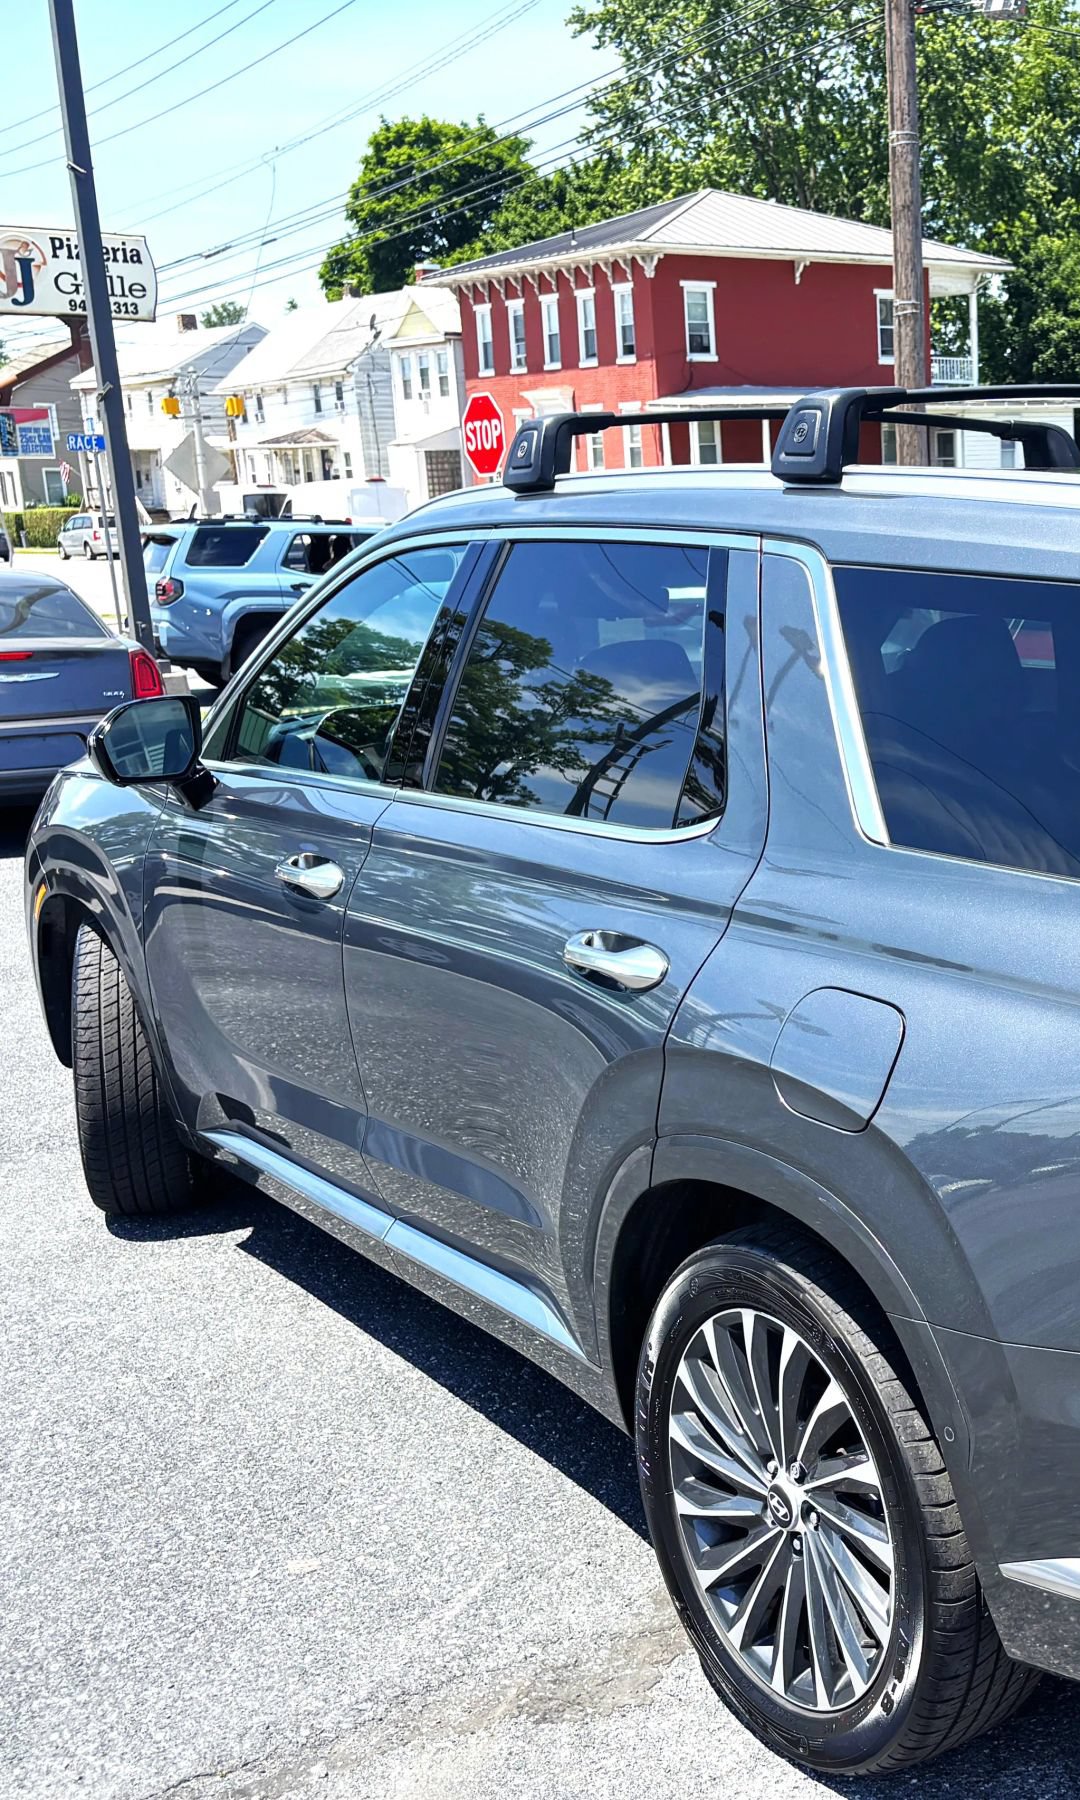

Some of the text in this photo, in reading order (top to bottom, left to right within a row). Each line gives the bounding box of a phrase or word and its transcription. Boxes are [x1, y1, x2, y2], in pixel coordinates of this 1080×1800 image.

[49, 236, 143, 265] Pieria
[54, 271, 147, 299] Glle
[68, 435, 99, 451] RACE
[465, 418, 501, 452] STOP
